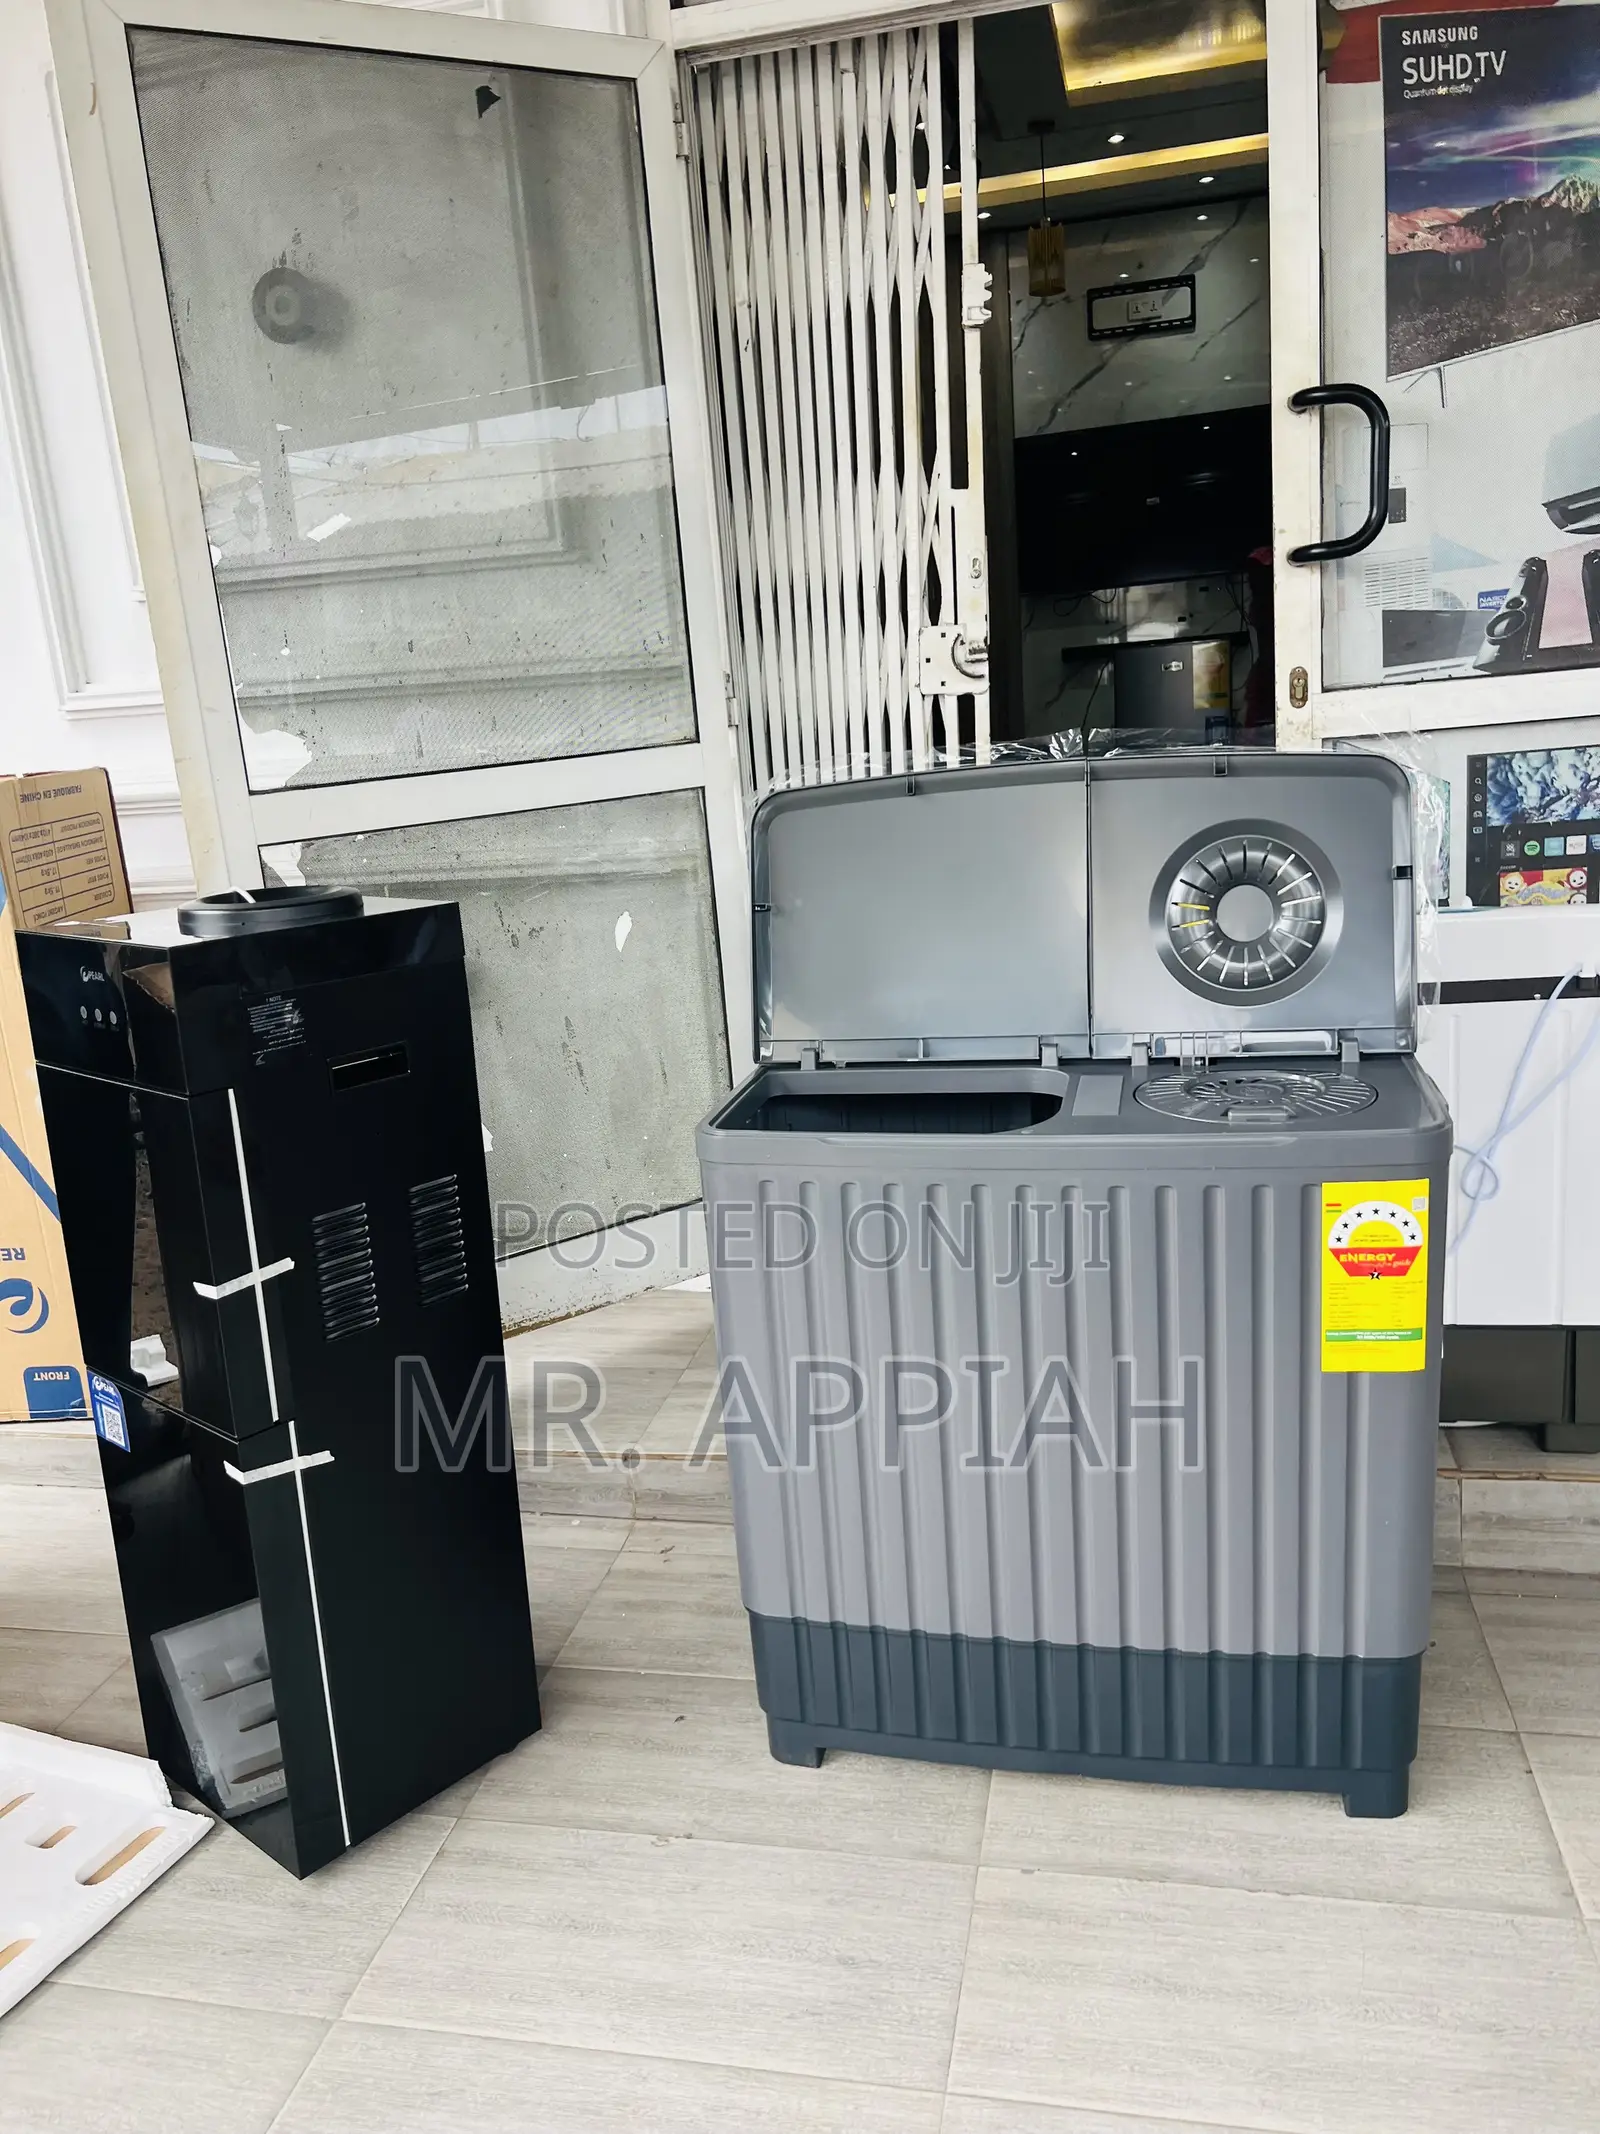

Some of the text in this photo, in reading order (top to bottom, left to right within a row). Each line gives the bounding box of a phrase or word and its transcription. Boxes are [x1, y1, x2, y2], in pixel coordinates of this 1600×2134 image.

[1401, 26, 1478, 46] SAMSUNG
[1402, 50, 1507, 85] SUHD TV
[1403, 88, 1437, 100] Quantum
[1449, 83, 1473, 96] display
[0, 1247, 26, 1261] RE
[1339, 1252, 1396, 1264] ENERGY
[33, 1370, 70, 1382] FRONT
